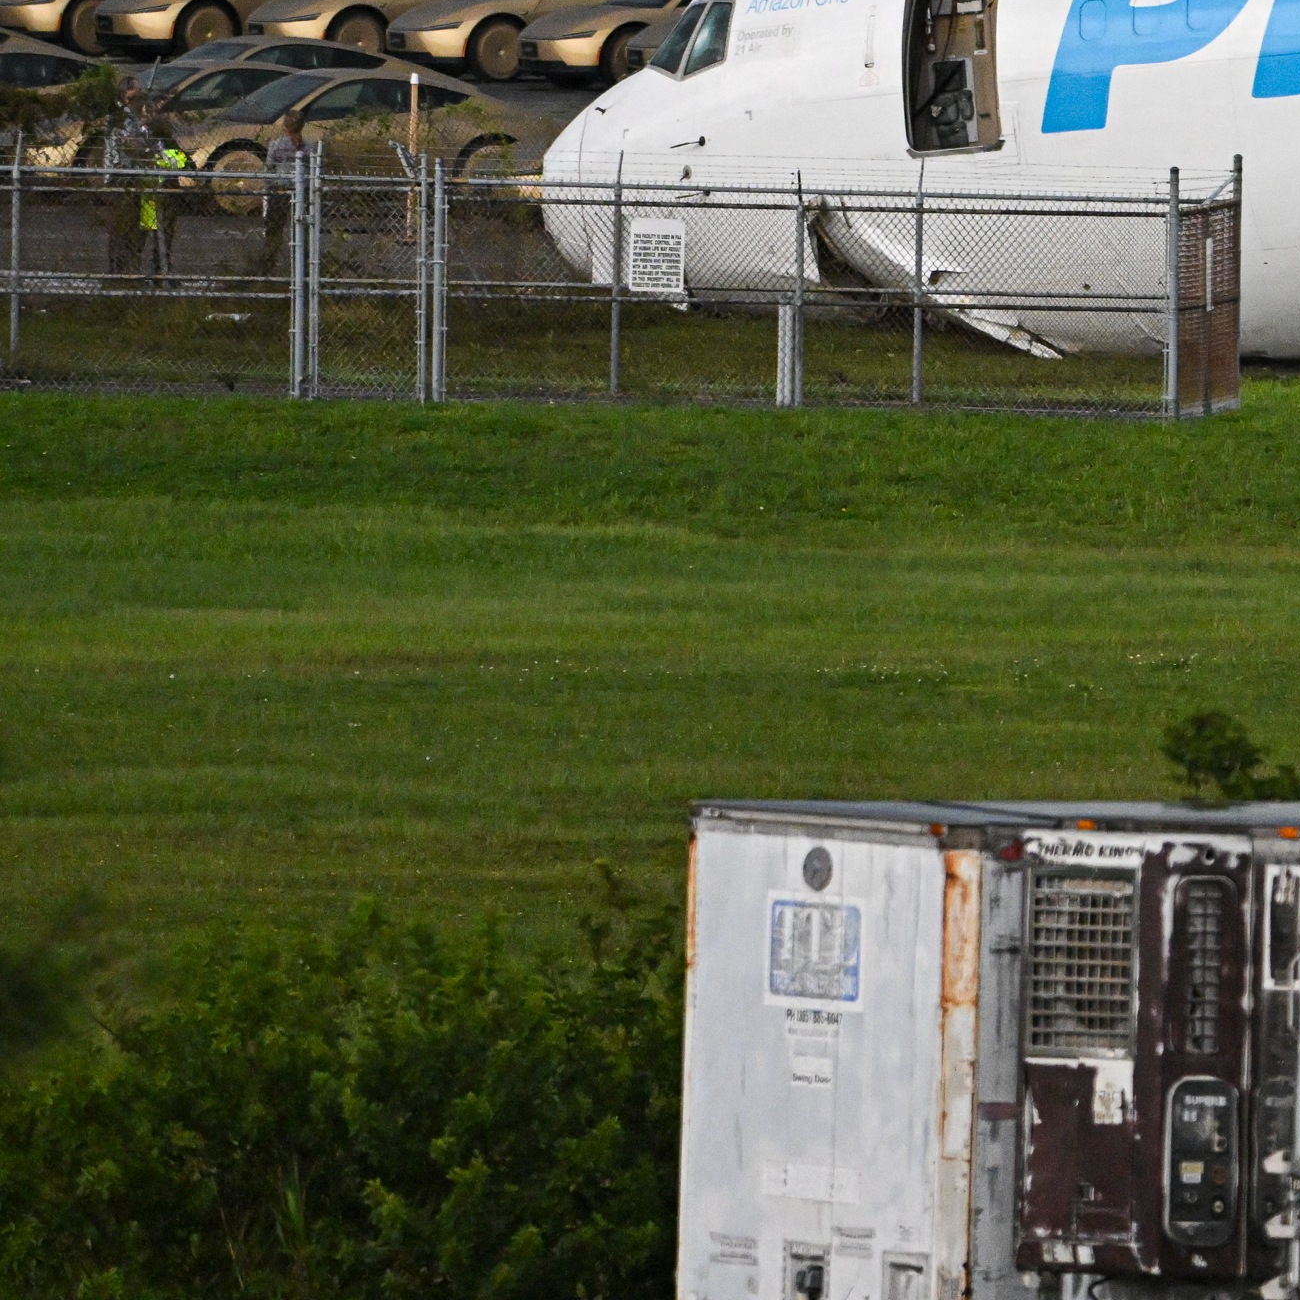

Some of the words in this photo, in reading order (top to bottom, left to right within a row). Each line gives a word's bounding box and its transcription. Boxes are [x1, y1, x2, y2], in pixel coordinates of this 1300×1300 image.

[737, 26, 779, 42] Operated
[781, 24, 794, 38] by
[734, 44, 746, 56] 21
[748, 43, 762, 53] Air
[792, 1072, 813, 1084] Swing
[814, 1074, 832, 1084] Door
